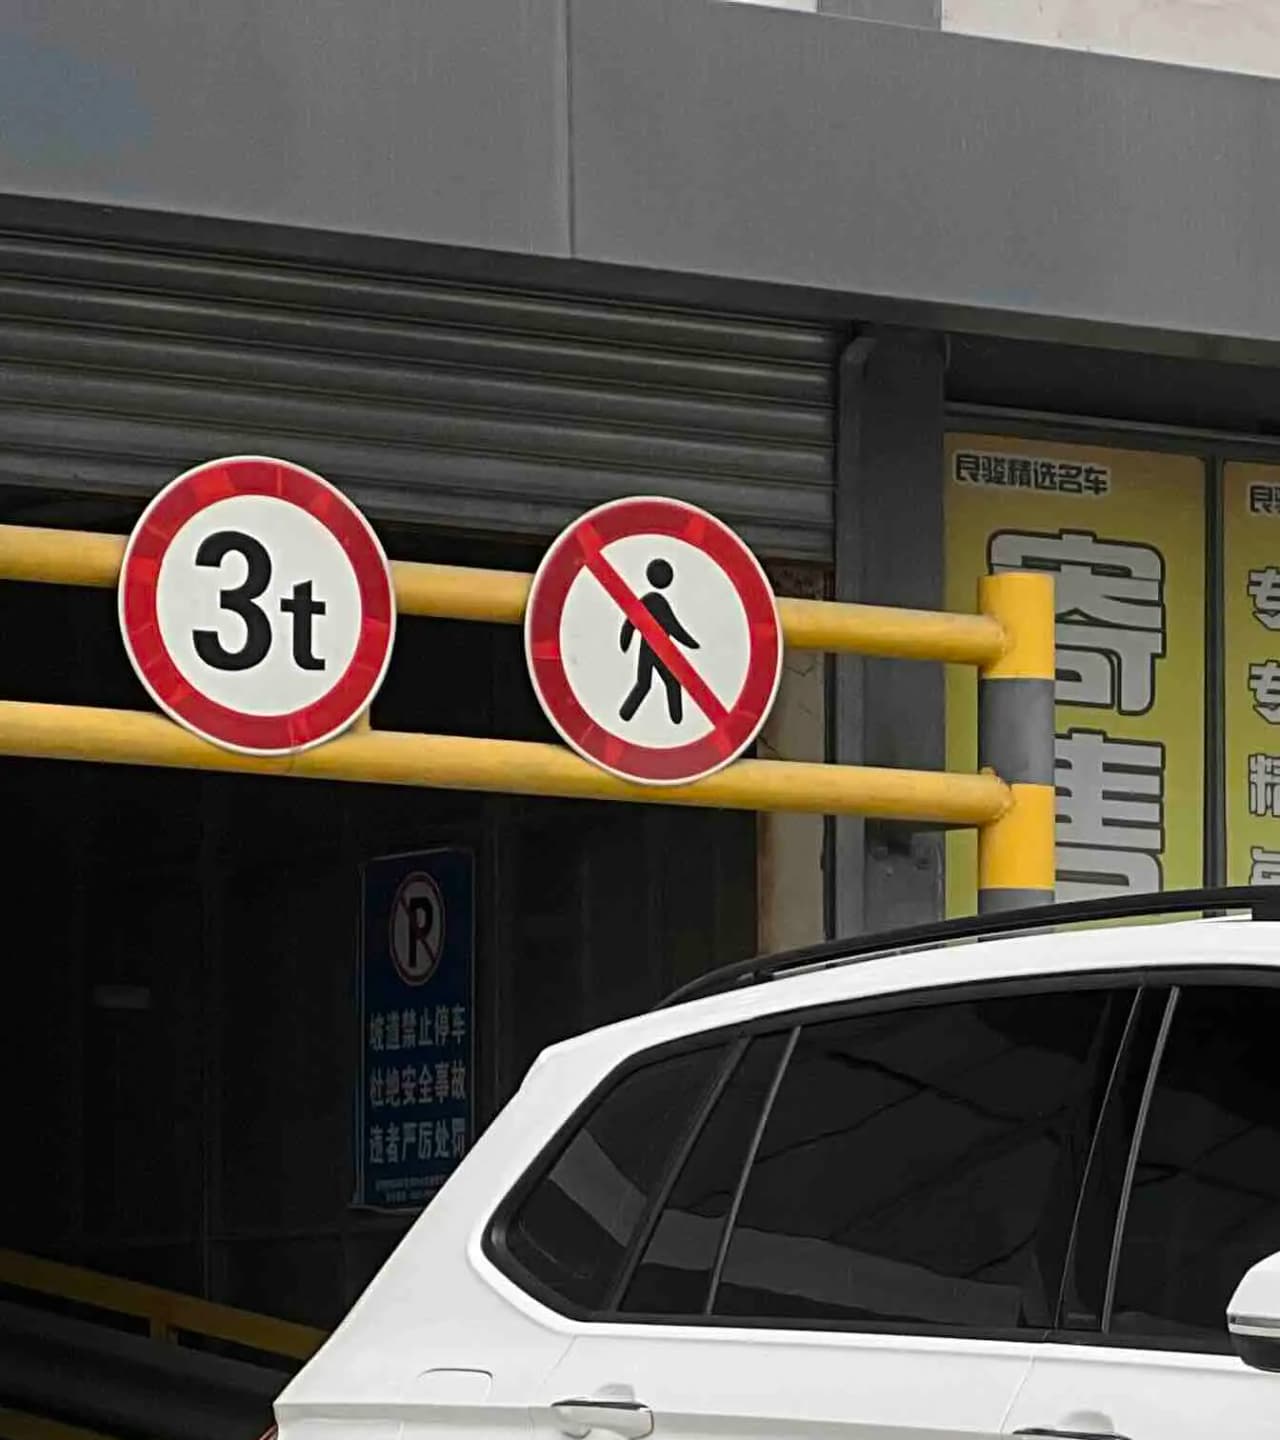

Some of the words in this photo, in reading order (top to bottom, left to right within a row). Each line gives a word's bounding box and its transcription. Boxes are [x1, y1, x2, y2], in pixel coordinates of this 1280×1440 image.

[956, 453, 1108, 495] 良骏精选名车
[191, 531, 326, 672] 3t
[369, 1005, 466, 1052] 坡道禁止停车
[369, 1058, 466, 1109] 杜绝安全事故
